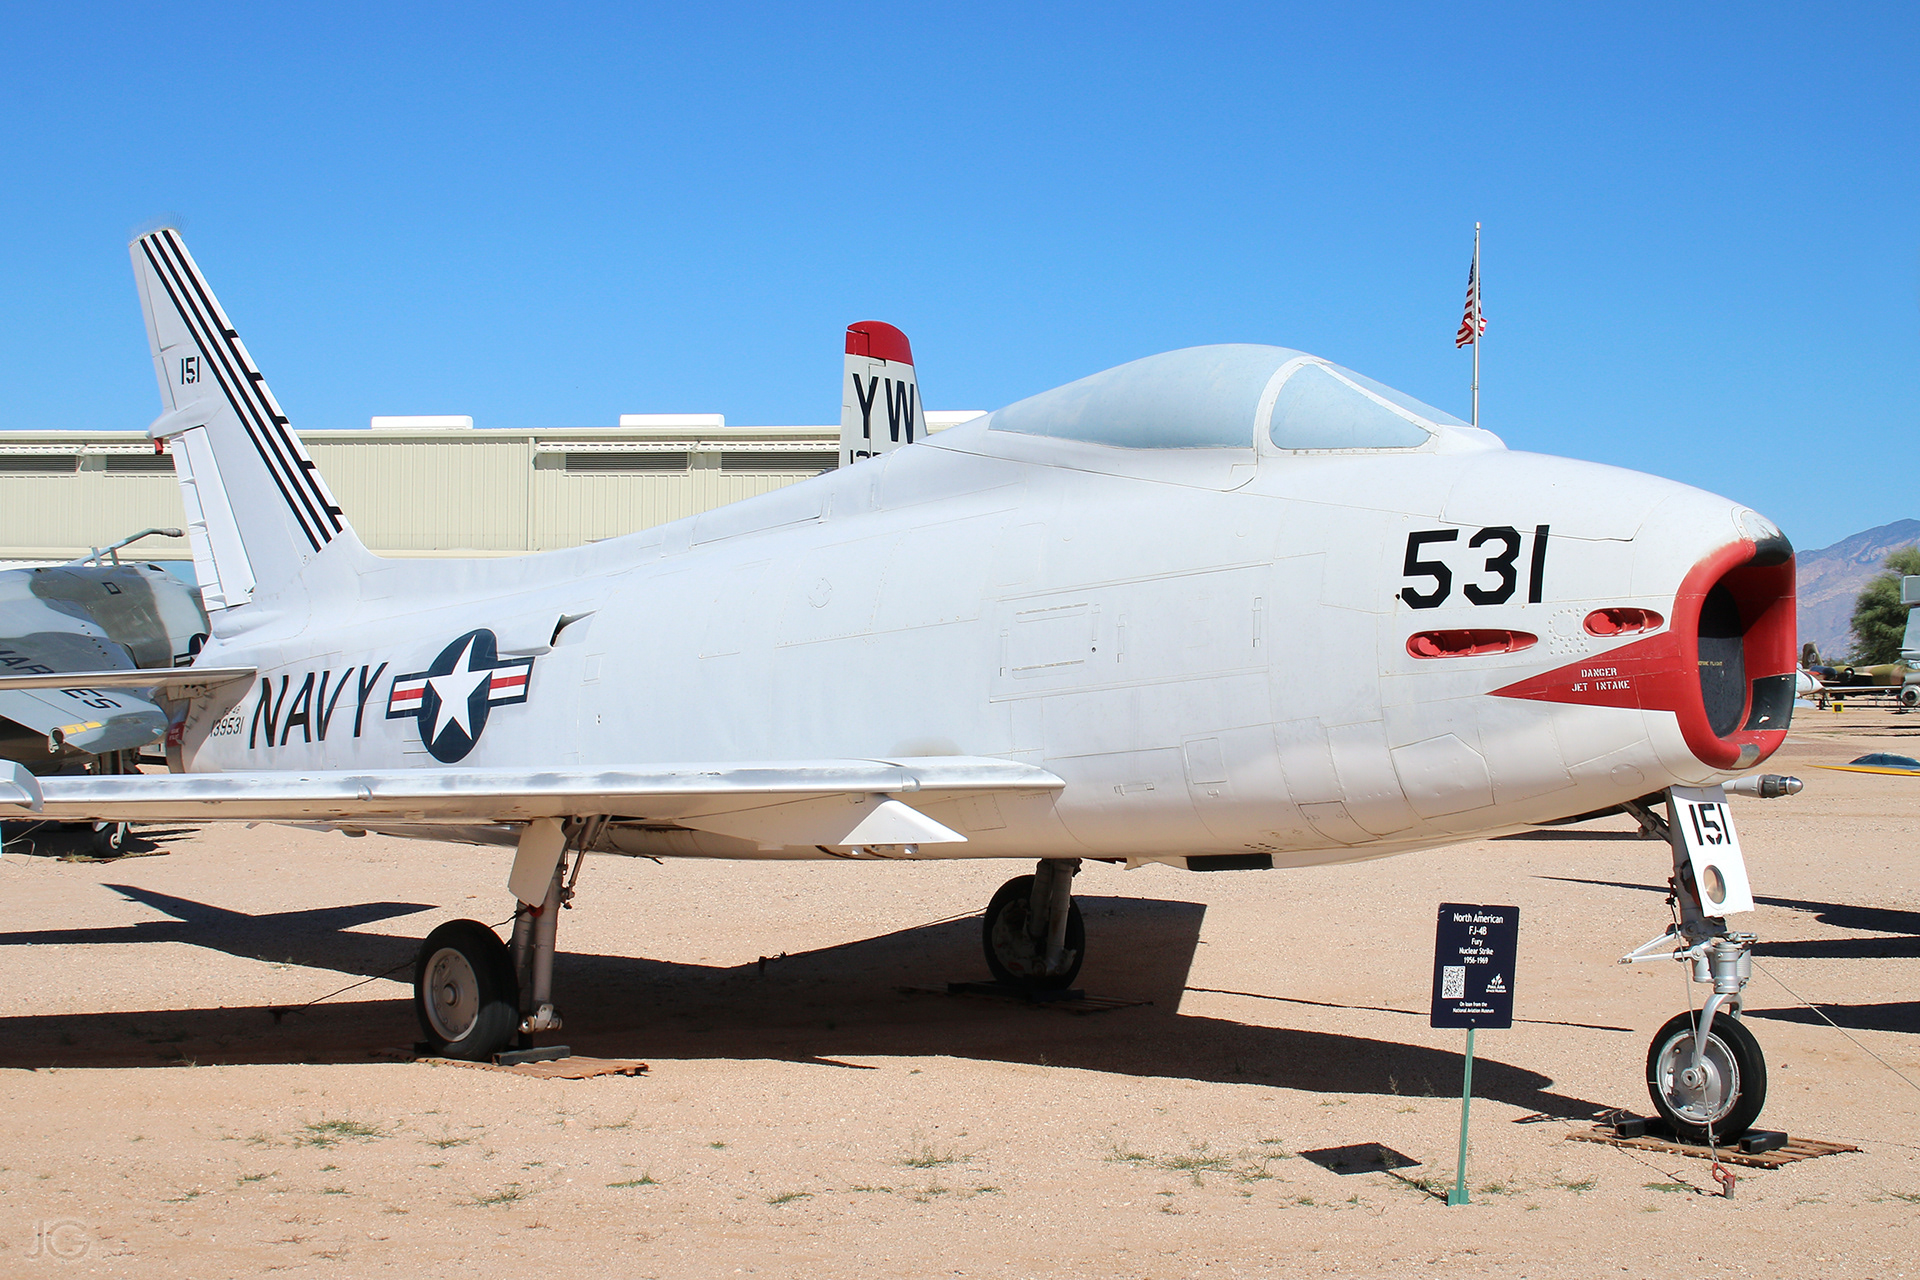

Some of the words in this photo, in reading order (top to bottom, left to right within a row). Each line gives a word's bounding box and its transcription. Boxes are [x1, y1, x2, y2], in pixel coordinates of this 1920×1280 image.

[181, 356, 200, 385] 151
[852, 373, 915, 444] YW
[1401, 524, 1550, 610] 531
[1581, 667, 1617, 678] DANGER
[1571, 682, 1588, 692] JET
[1596, 680, 1630, 691] INTAKE
[250, 661, 390, 750] NAVY
[210, 716, 245, 737] 139531
[1688, 803, 1731, 846] 151
[1453, 913, 1473, 923] North
[1473, 914, 1504, 924] American
[1468, 925, 1488, 936] FJ-4B
[1471, 938, 1483, 947] Fury
[1458, 947, 1478, 955] Nuclear
[1479, 947, 1494, 956] Strike
[1463, 956, 1489, 965] 1956-1969
